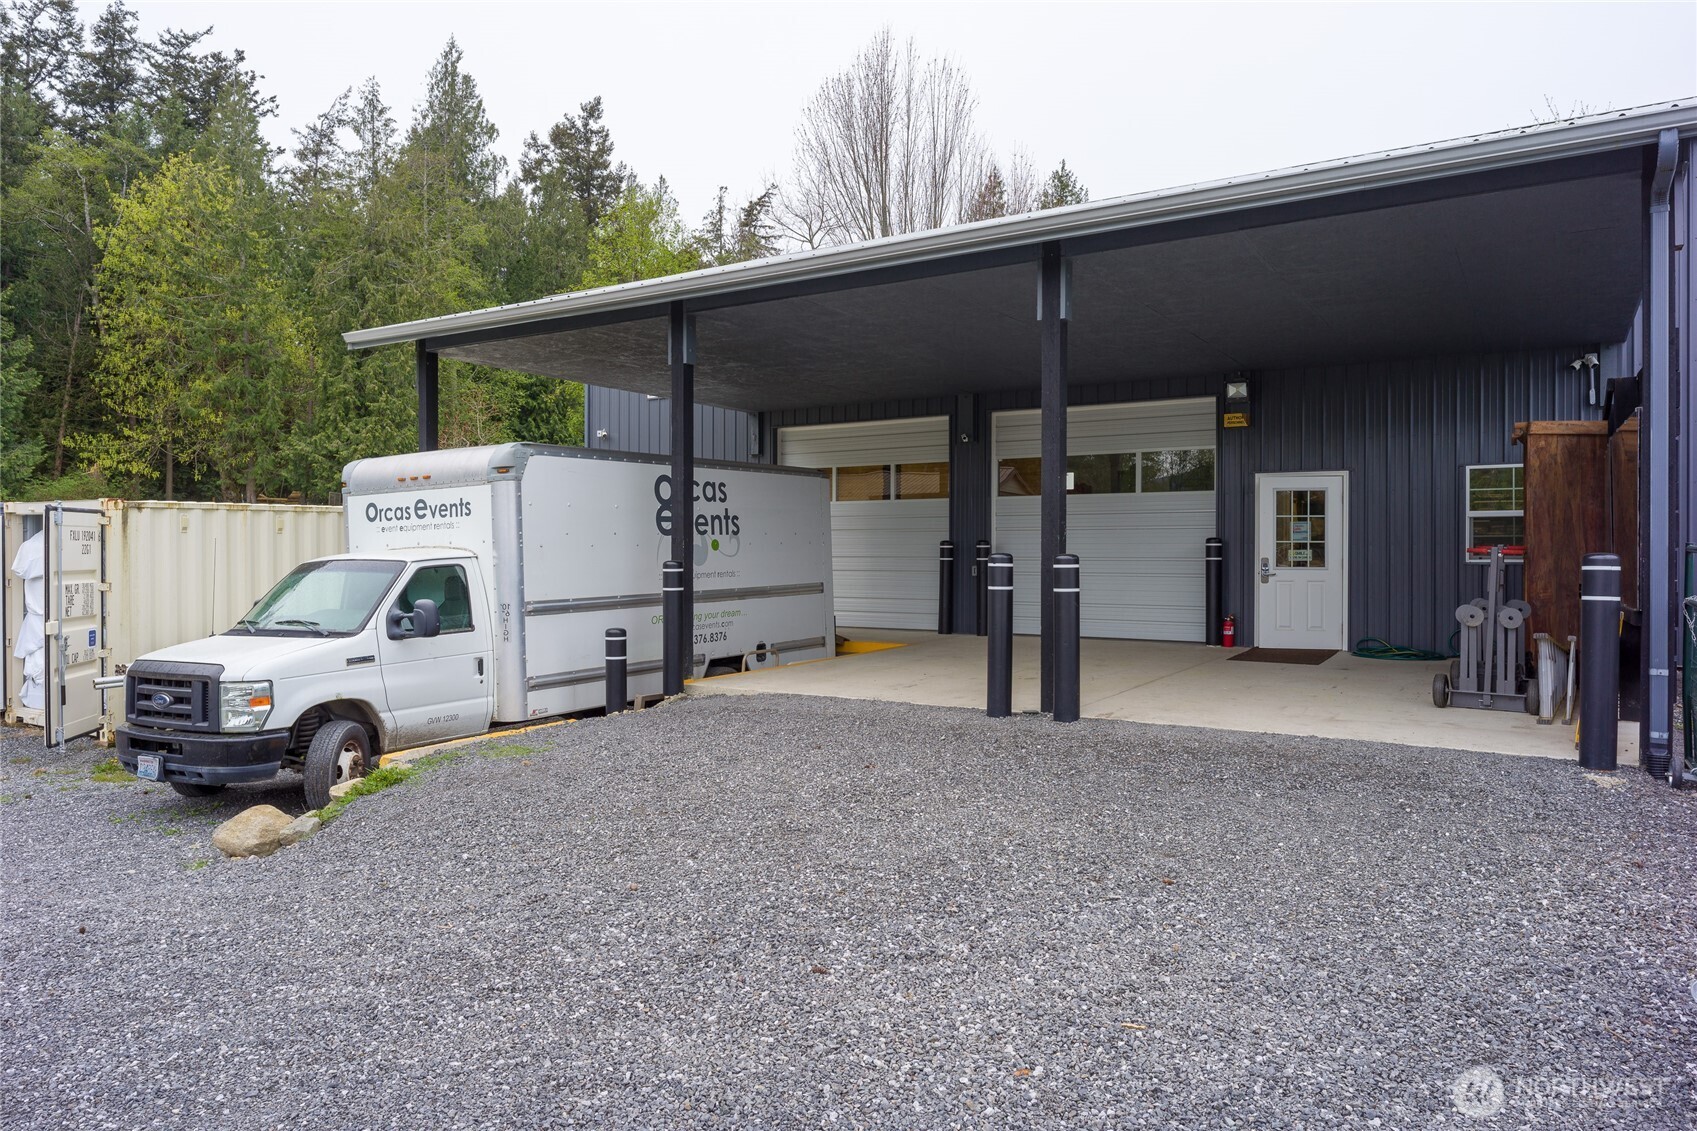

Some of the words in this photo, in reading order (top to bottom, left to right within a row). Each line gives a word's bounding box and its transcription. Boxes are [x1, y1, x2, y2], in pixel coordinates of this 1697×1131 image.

[654, 474, 728, 504] Ocas
[365, 502, 412, 523] Orcas
[414, 498, 472, 520] events
[656, 504, 740, 536] eents
[381, 525, 398, 533] event
[399, 522, 433, 533] equipment
[434, 521, 455, 530] rentals
[693, 571, 716, 580] ipment
[717, 570, 736, 578] rentals
[704, 612, 719, 622] your
[694, 631, 728, 645] 376.8376
[427, 716, 442, 725] GVW
[443, 713, 460, 723] 12300
